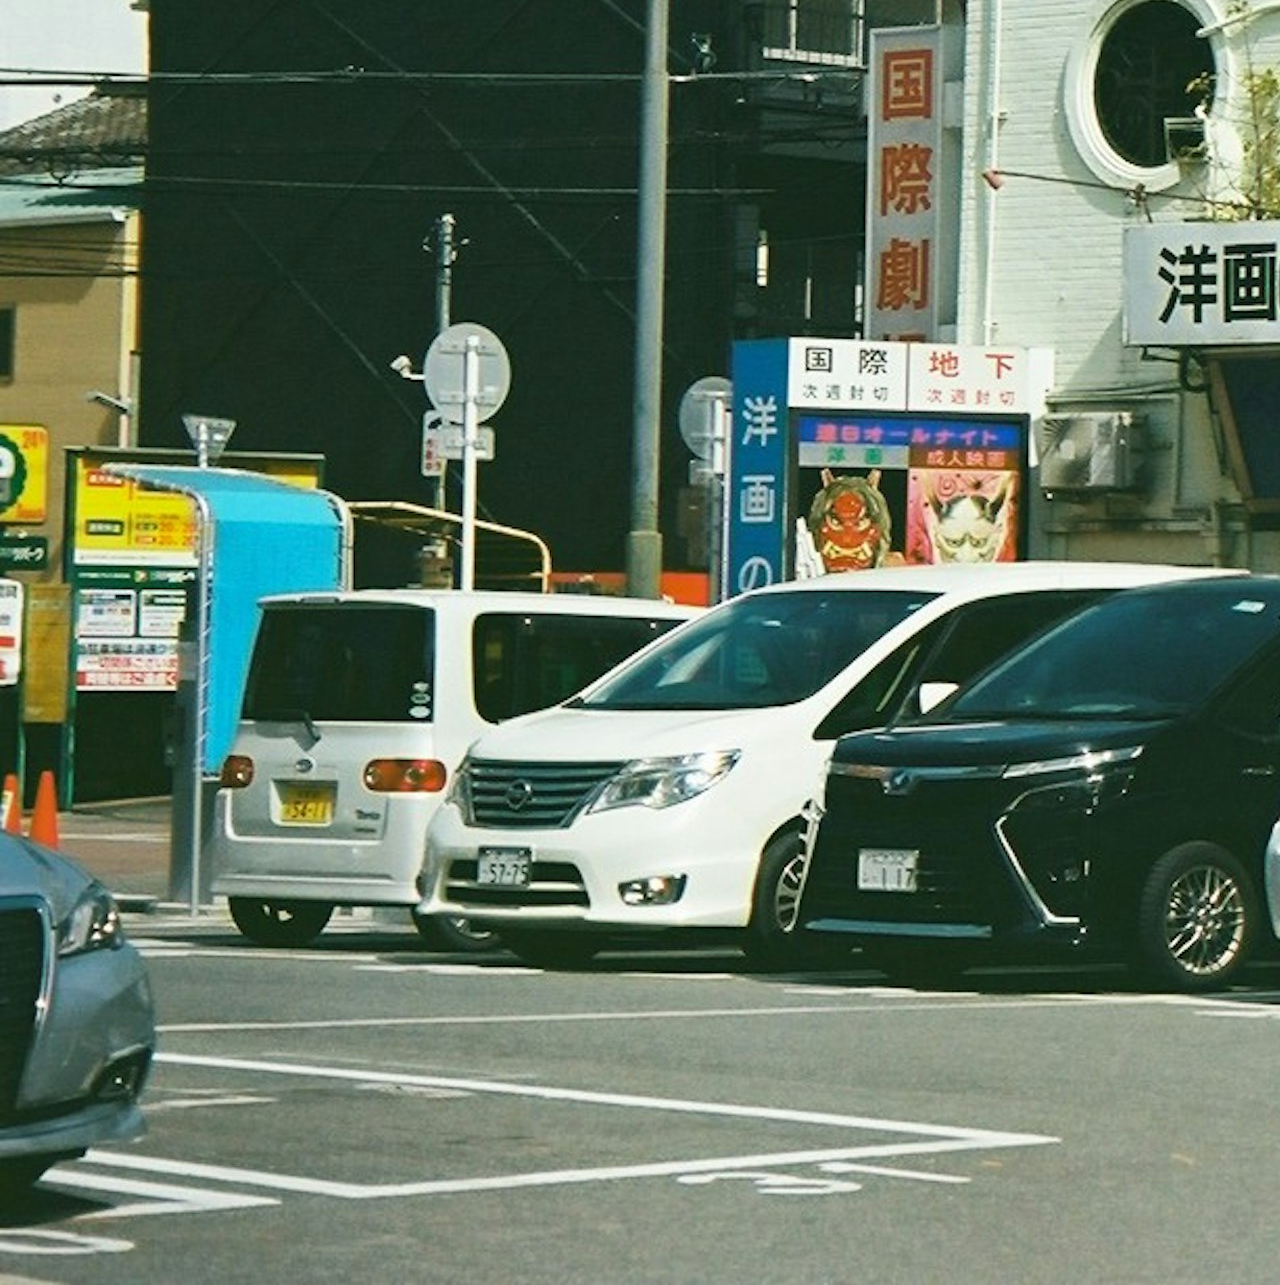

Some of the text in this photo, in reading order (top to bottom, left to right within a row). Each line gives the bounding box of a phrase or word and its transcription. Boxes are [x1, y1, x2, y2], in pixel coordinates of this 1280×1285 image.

[876, 49, 933, 342] 国際劇
[805, 347, 888, 375] 国際
[929, 351, 1015, 379] 地下
[803, 384, 889, 402] 次週封切
[927, 389, 1015, 406] 次週封切
[737, 395, 778, 594] 洋画の
